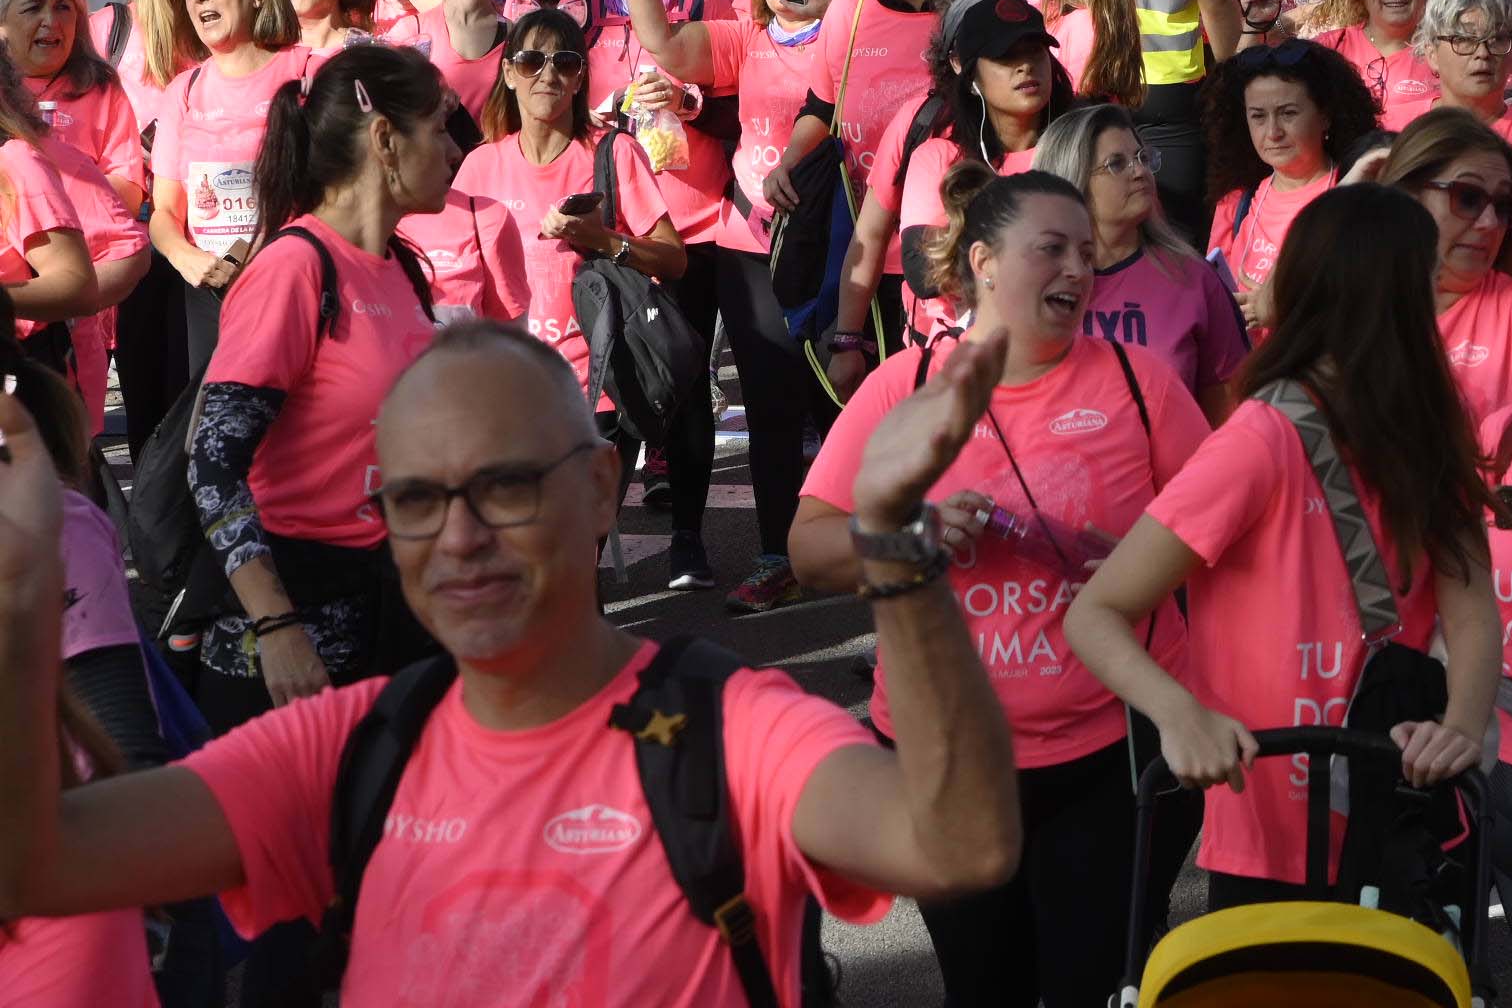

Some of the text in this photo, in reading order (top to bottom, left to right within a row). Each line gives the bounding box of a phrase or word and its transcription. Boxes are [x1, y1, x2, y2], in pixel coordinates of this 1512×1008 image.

[223, 197, 256, 211] 016
[1053, 419, 1104, 431] ASTURIANA
[964, 578, 1075, 617] ORSA
[1297, 641, 1343, 681] TU
